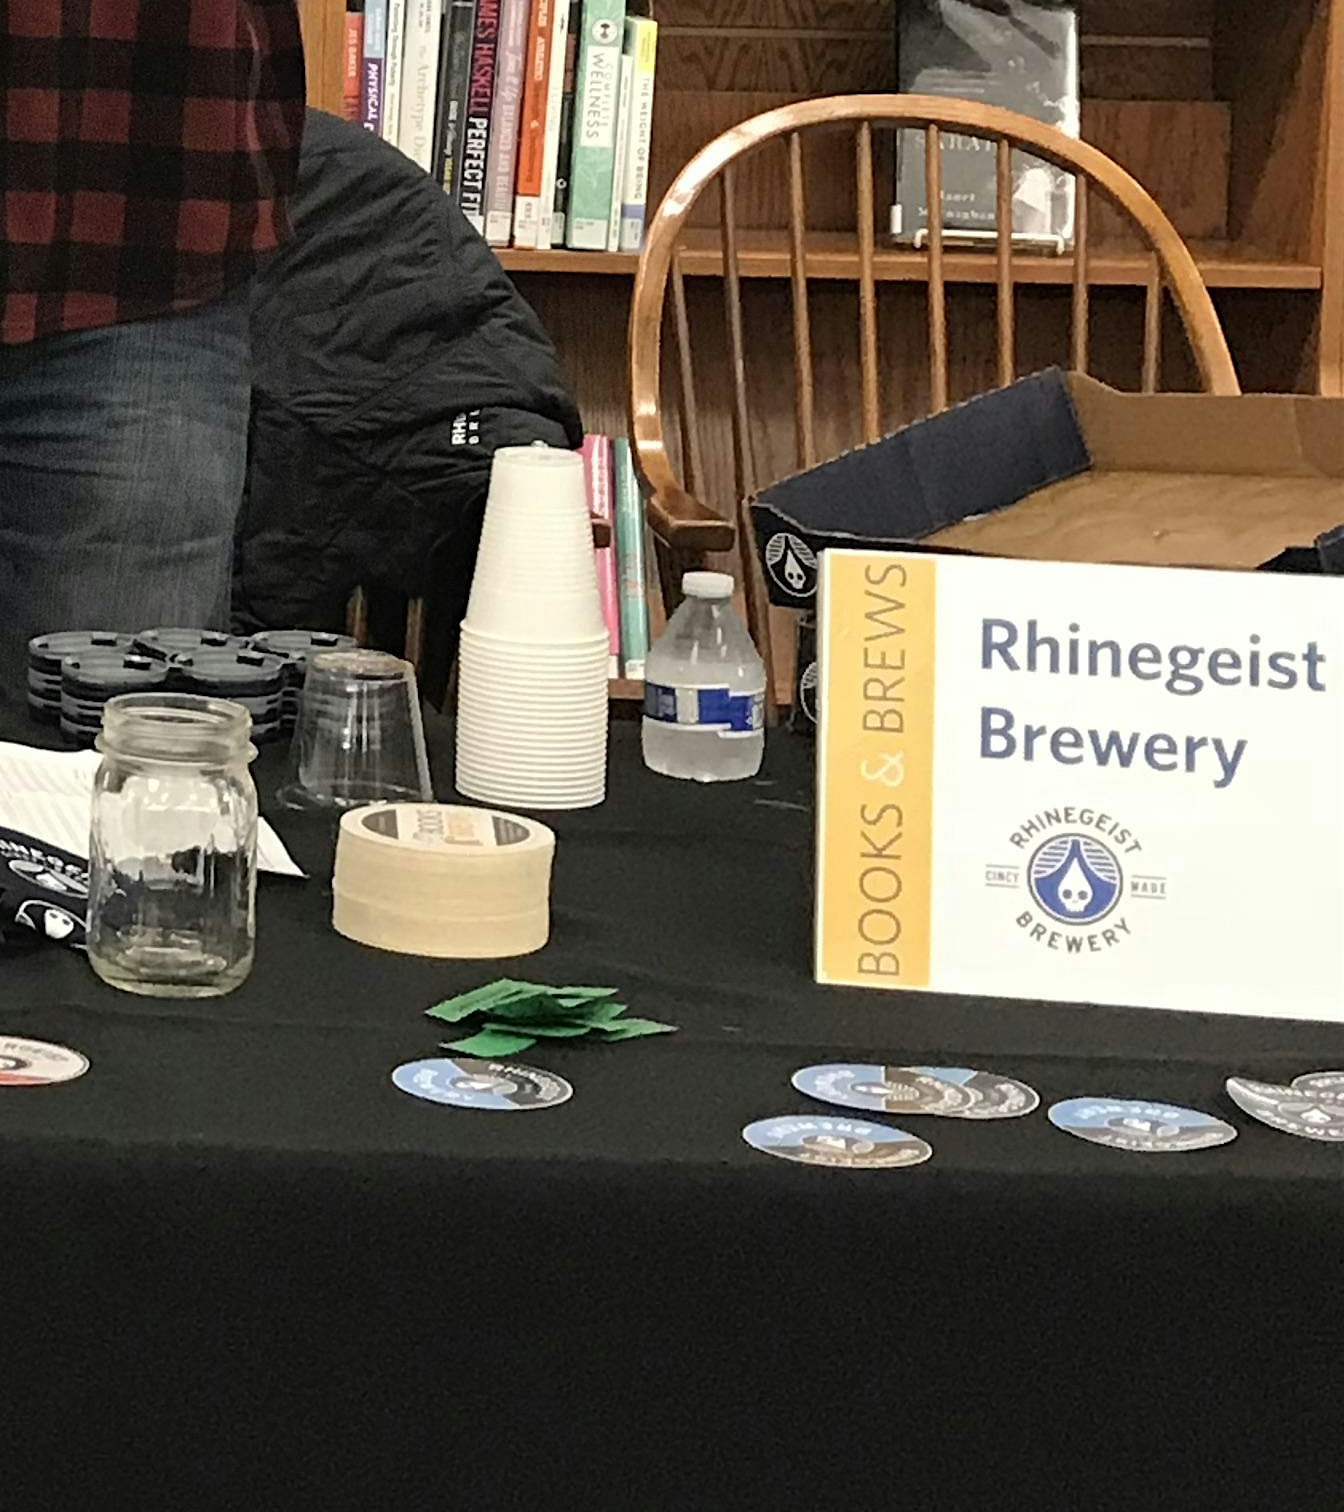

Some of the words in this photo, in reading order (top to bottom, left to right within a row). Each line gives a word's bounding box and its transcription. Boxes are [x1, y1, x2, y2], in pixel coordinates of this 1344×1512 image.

[365, 63, 381, 121] PHYSICAL
[411, 62, 431, 132] Archetype
[468, 43, 496, 116] HASKELL
[586, 53, 607, 140] WELLNESS
[641, 77, 651, 97] THE
[637, 102, 649, 144] WEIGHT
[462, 117, 489, 190] PERFECT
[637, 148, 646, 163] OF
[460, 192, 483, 216] FIT
[633, 165, 645, 200] BEING
[861, 564, 909, 734] BREWS
[981, 618, 1327, 696] Rhinegeist
[861, 751, 905, 786] &
[979, 706, 1248, 788] Brewery
[1010, 805, 1143, 855] RHINEGEIST
[857, 802, 904, 977] BOOKS
[985, 870, 1020, 884] CINCY
[1131, 881, 1167, 894] MADE
[1014, 910, 1133, 954] BREWERY
